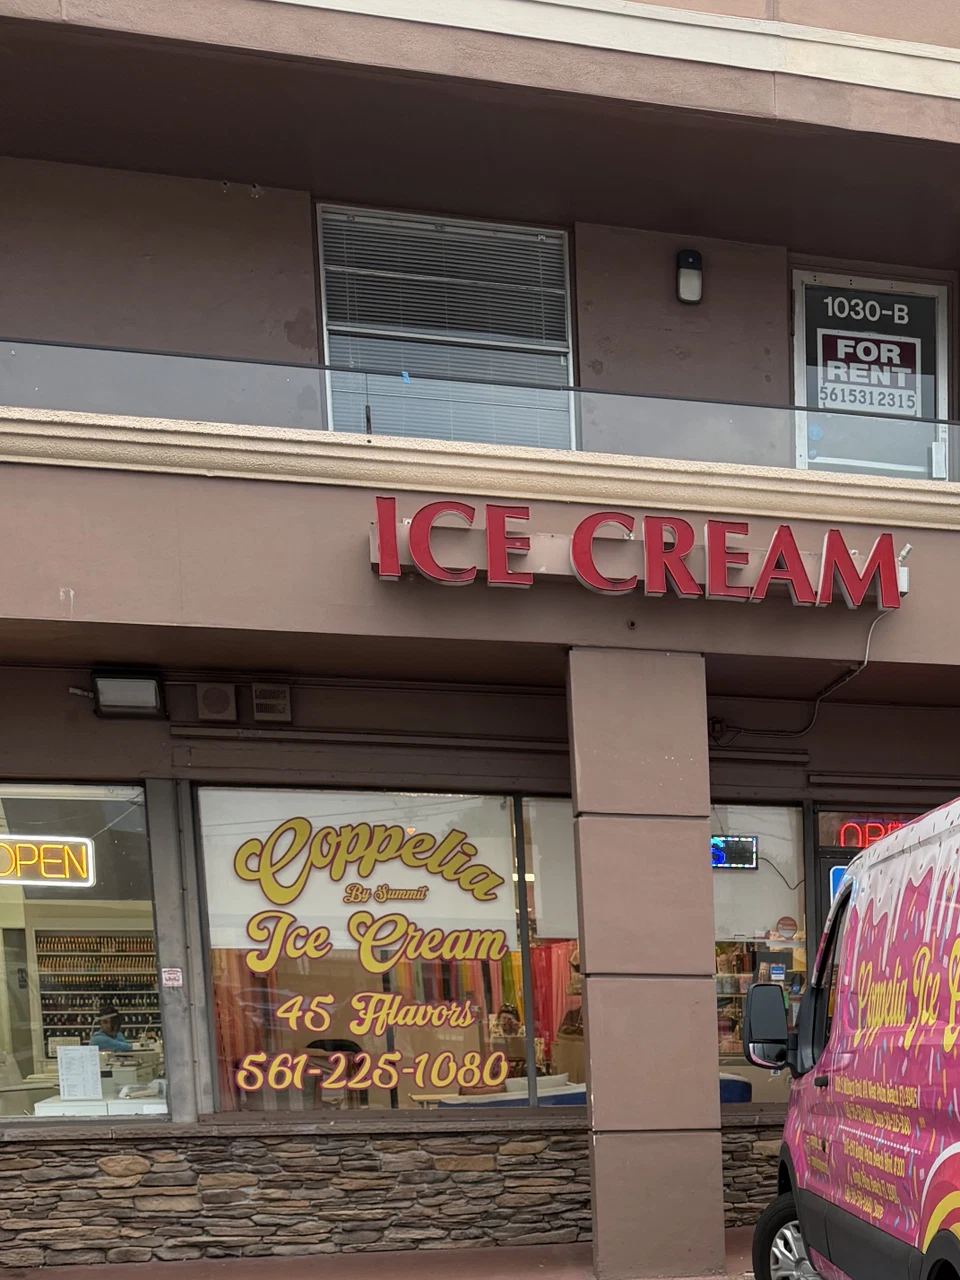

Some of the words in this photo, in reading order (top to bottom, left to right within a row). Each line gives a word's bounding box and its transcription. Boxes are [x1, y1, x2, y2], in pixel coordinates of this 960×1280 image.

[823, 296, 909, 325] 1030-B
[837, 338, 901, 364] FOR
[827, 360, 912, 387] RENT
[820, 386, 916, 410] 5615312315
[373, 496, 534, 589] ICE
[569, 511, 901, 610] CREAM
[840, 821, 907, 849] OP
[234, 816, 505, 905] Coppelia
[343, 882, 372, 904] By
[373, 883, 430, 904] Summit
[246, 910, 333, 973] Ice
[348, 910, 508, 974] Cream
[275, 993, 335, 1032] 45
[904, 946, 942, 1051] Ice
[235, 1050, 510, 1090] 561-225-1080
